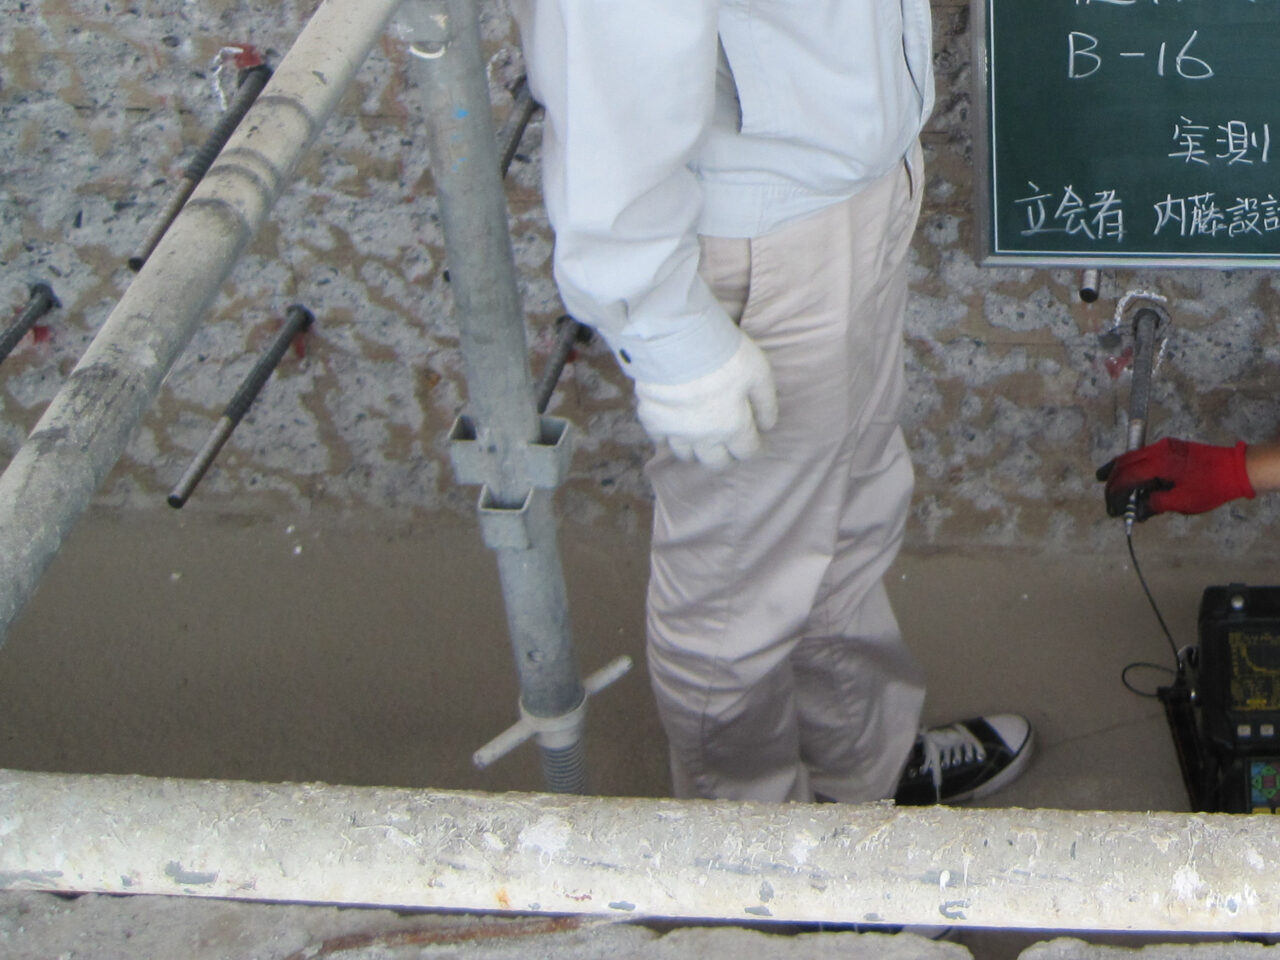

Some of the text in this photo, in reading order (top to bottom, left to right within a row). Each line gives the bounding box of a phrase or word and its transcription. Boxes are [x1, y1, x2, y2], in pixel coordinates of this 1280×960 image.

[1167, 115, 1270, 166] 実測
[1014, 180, 1125, 242] 立会者
